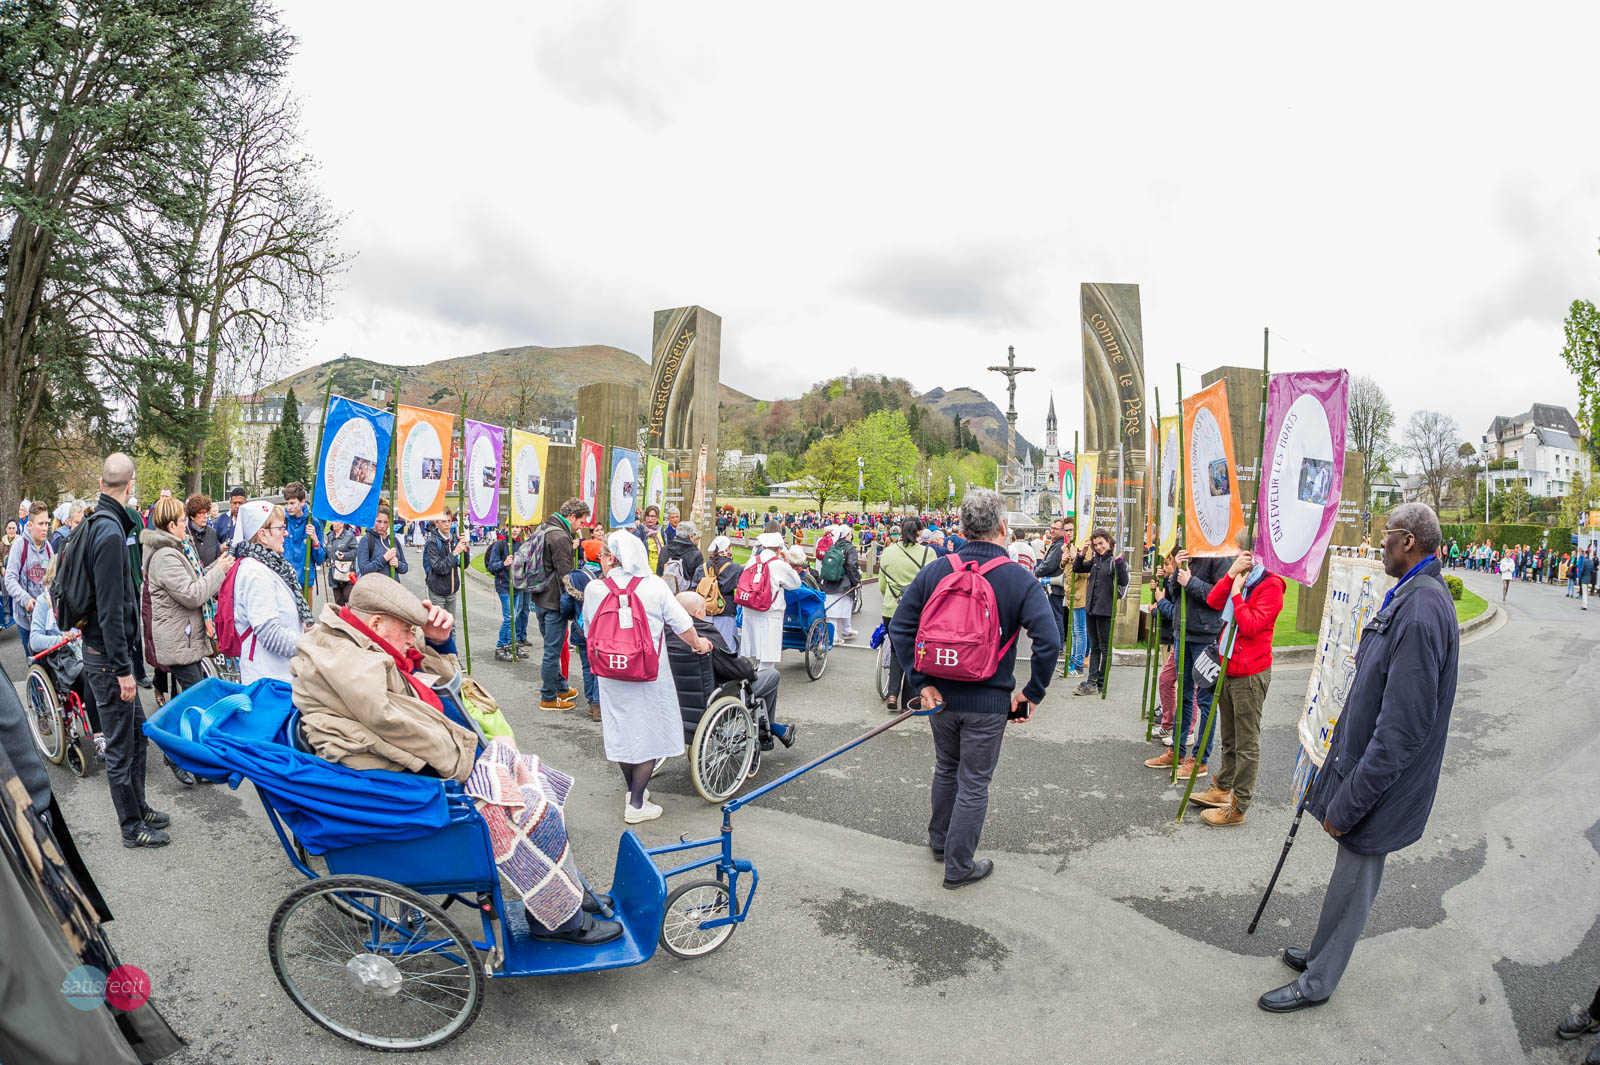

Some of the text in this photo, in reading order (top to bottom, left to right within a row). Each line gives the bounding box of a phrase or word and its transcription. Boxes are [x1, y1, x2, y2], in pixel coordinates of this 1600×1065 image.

[1090, 313, 1125, 364] comme
[1118, 373, 1133, 388] le
[1269, 411, 1298, 543] ENSEVELIR LES MORTS
[608, 654, 628, 670] HB
[934, 647, 959, 667] HB
[1193, 650, 1221, 684] NIKE
